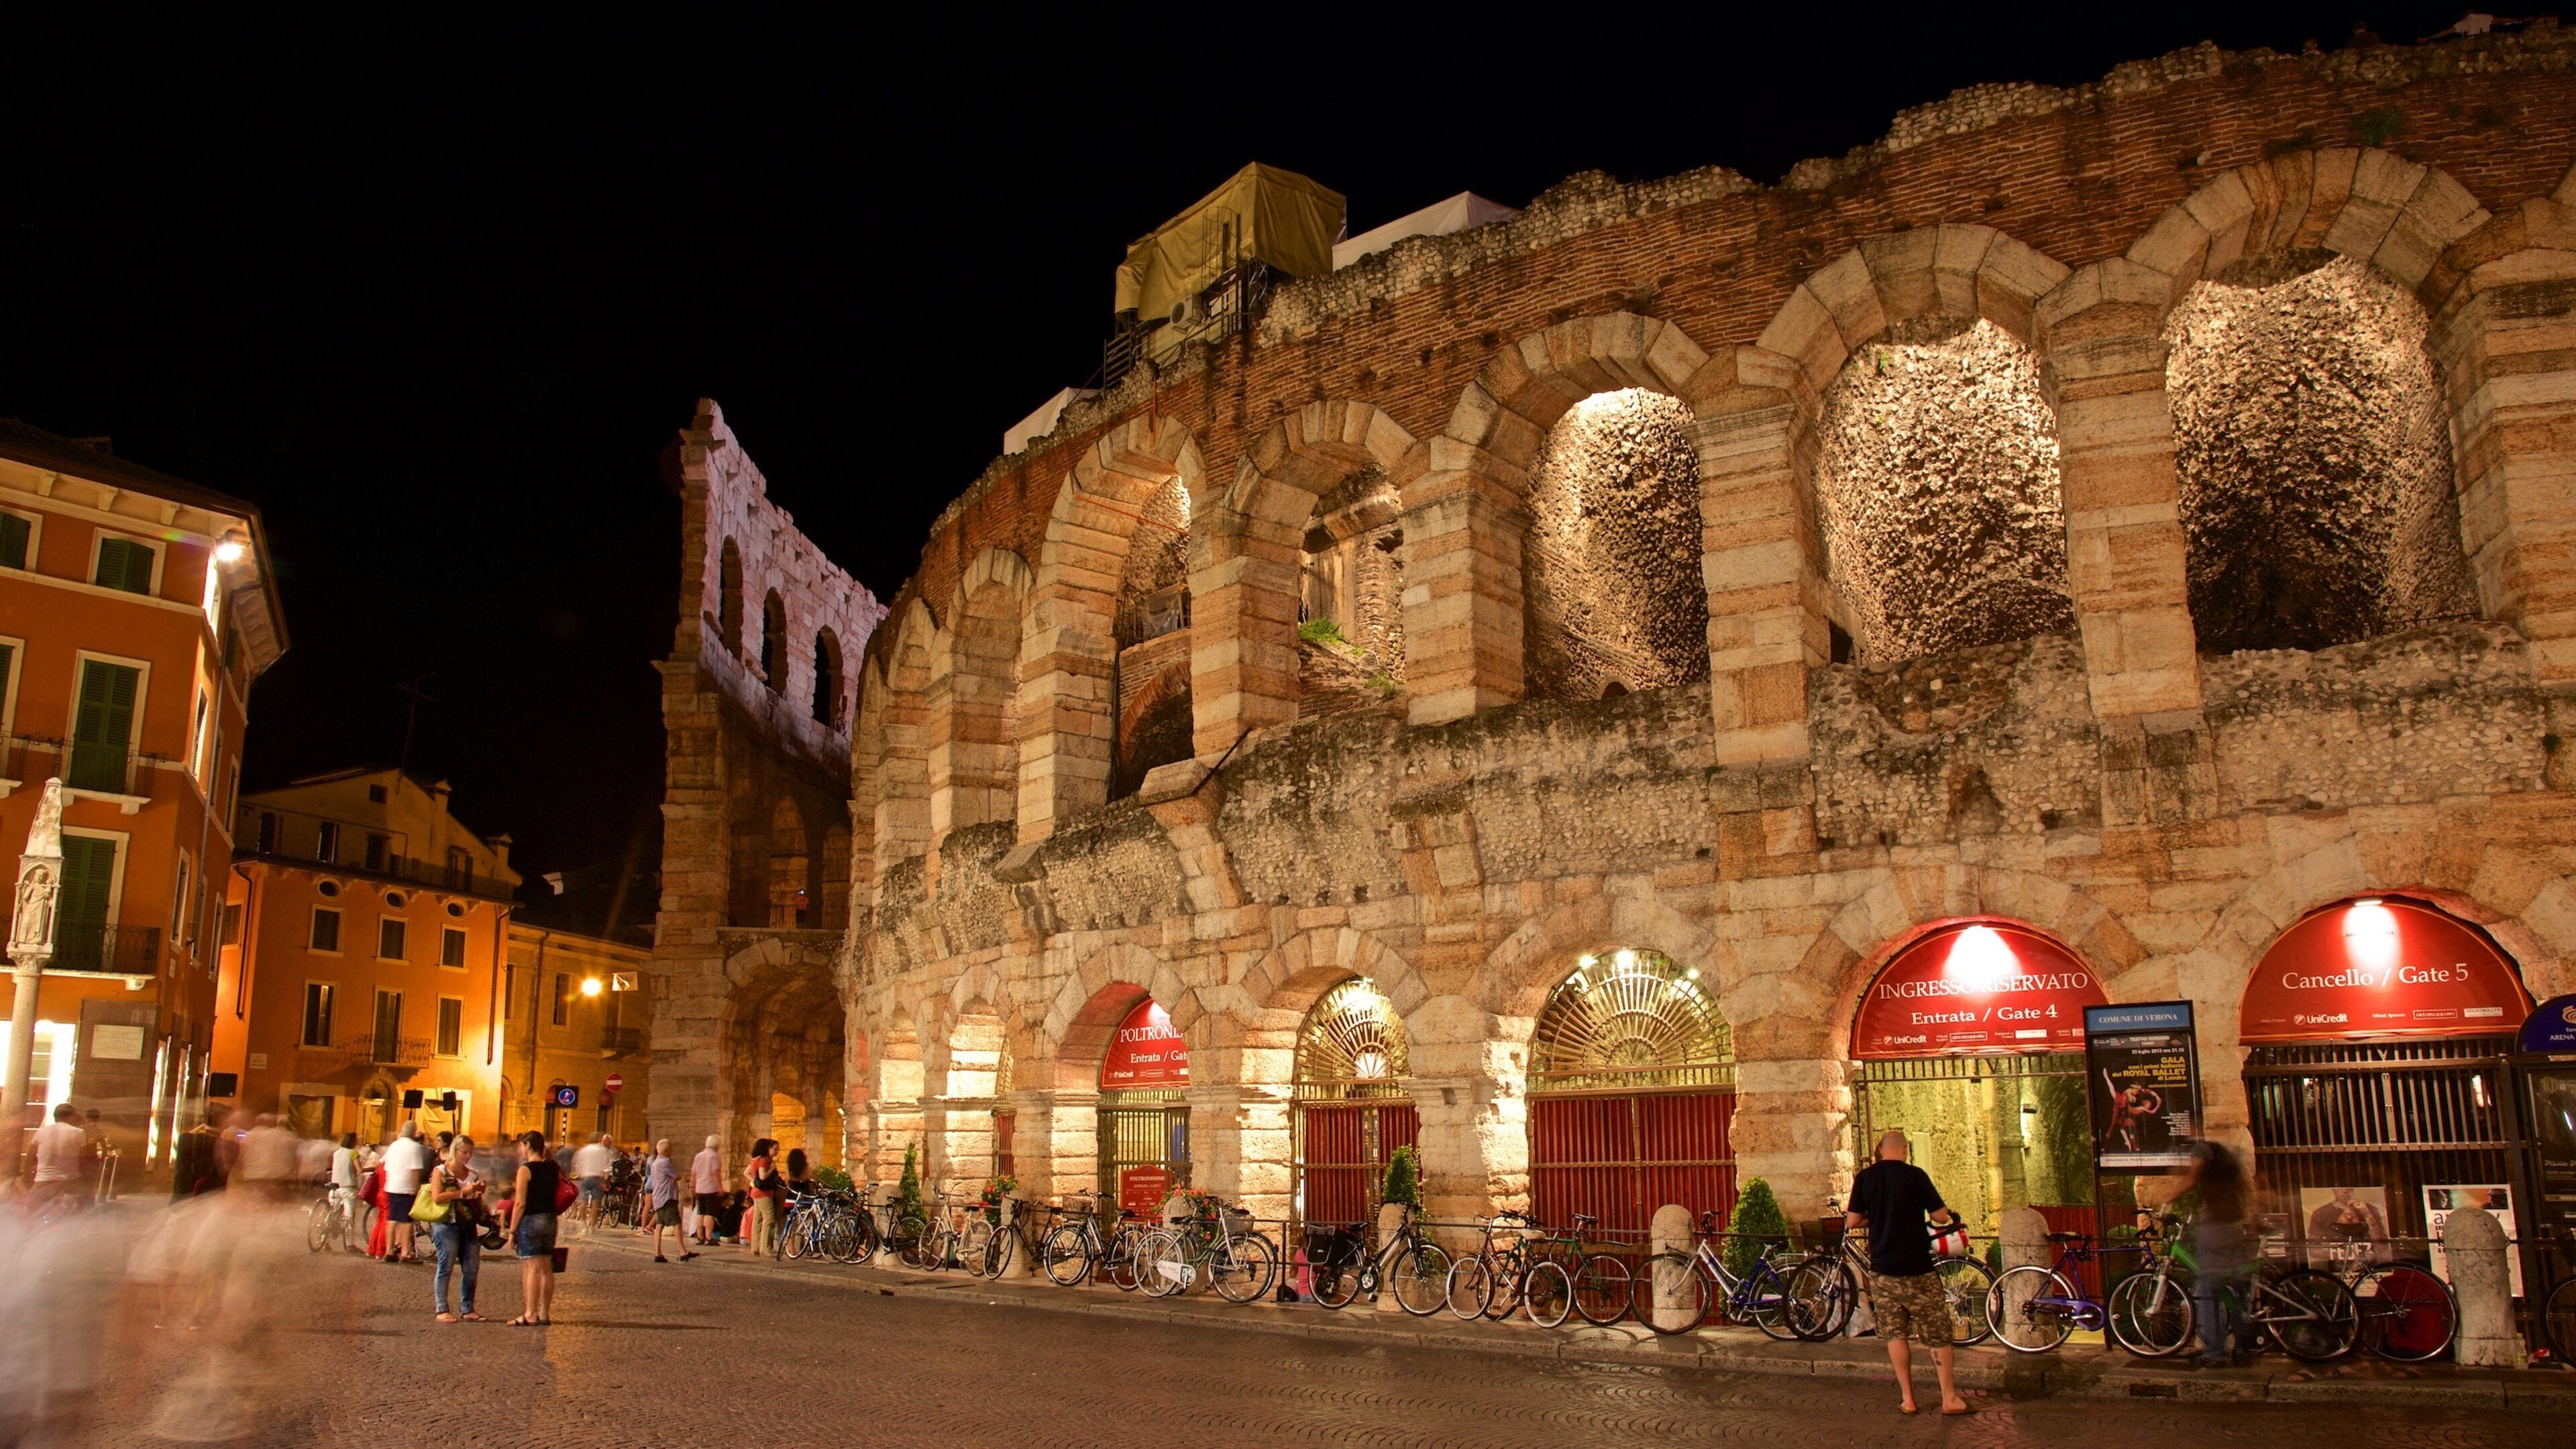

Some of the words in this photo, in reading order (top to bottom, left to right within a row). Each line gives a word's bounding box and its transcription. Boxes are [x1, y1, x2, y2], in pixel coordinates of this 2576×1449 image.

[2282, 969, 2374, 989] Cancello
[2398, 966, 2450, 983] Gate
[2455, 963, 2469, 981] 5
[1880, 979, 1972, 999] INGRESSO
[1978, 972, 2088, 994] RISERVATO
[1911, 1010, 1976, 1025] Entrata
[1982, 1008, 1992, 1022] /
[1997, 1006, 2041, 1020] Gate
[2045, 1004, 2058, 1018] 4
[2306, 1012, 2348, 1024] UniCredit
[1894, 1034, 1927, 1044] UniCredit
[1130, 1053, 1161, 1063] Entrata
[2161, 1056, 2186, 1064] GALA
[2123, 1069, 2151, 1077] ROYAL
[2152, 1068, 2186, 1076] BALLET
